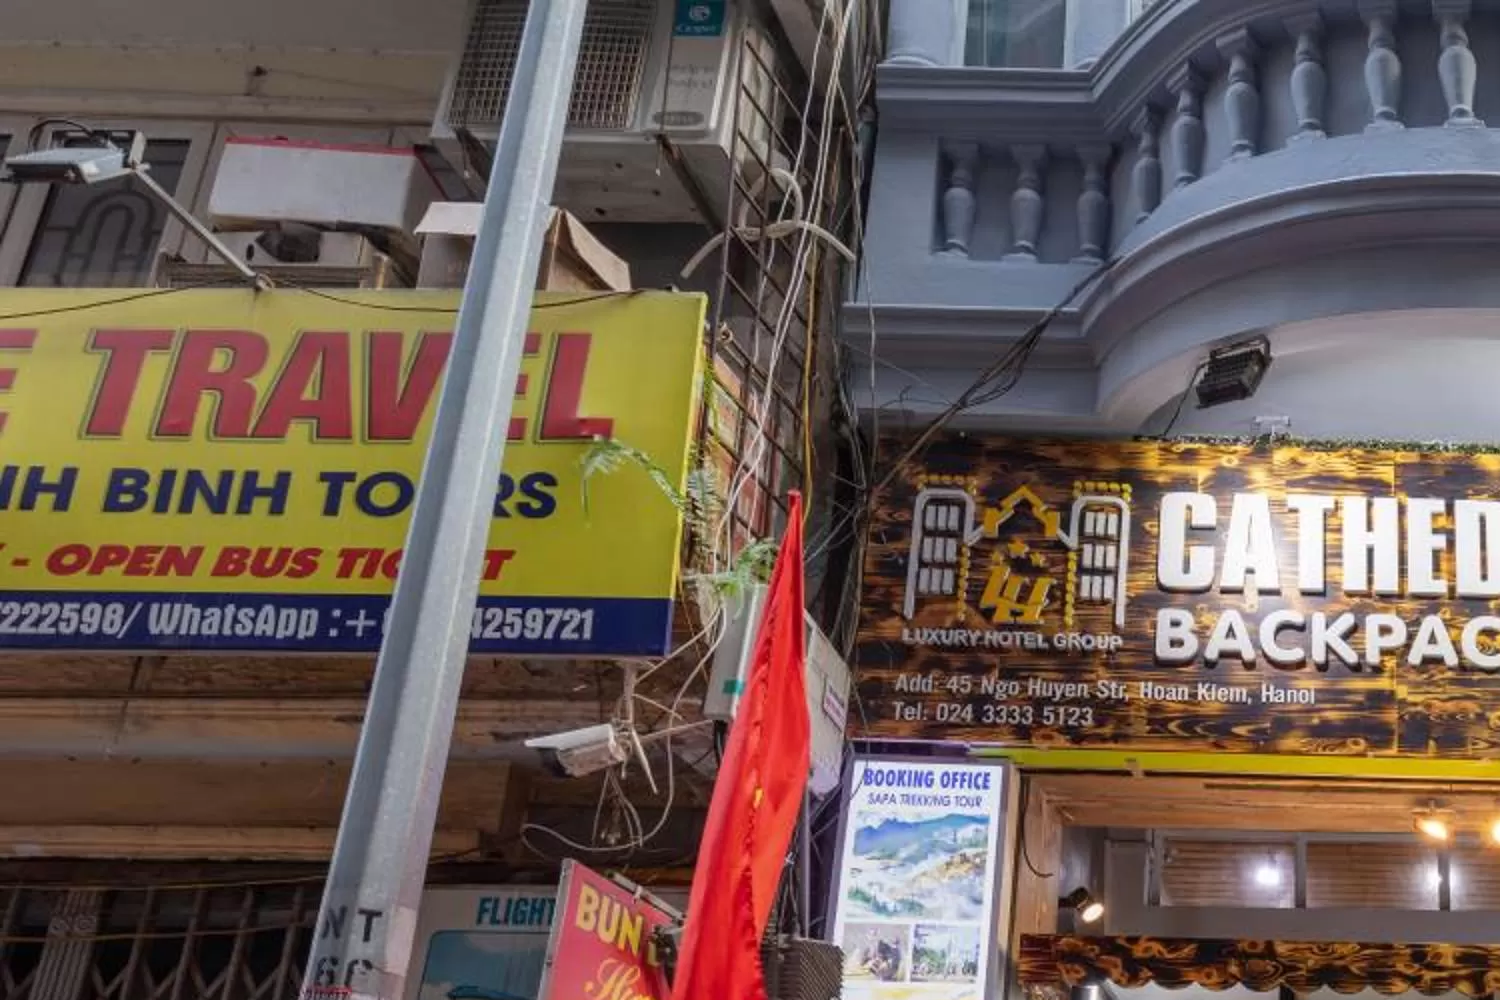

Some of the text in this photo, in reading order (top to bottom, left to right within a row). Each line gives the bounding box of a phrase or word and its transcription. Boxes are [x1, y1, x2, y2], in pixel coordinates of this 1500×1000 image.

[102, 467, 292, 516] BINH
[318, 470, 558, 519] TORS
[45, 543, 205, 577] OPEN
[210, 546, 323, 580] BUS
[335, 547, 516, 581] TICT
[147, 603, 319, 639] WhatsApp
[902, 629, 1124, 652] LUXURY HOTEL GROUP
[946, 676, 971, 694] 45
[981, 677, 1020, 701] Ngo
[1028, 678, 1091, 701] Huyen
[1139, 681, 1190, 702] Hoan
[1198, 683, 1253, 706] Kiem,
[1261, 684, 1316, 706] Hanoi
[894, 702, 1095, 727] Tel: 024 3333 5123
[863, 768, 991, 790] BOOKING OFFICE
[868, 793, 982, 807] SAPA TREKKING TOUR
